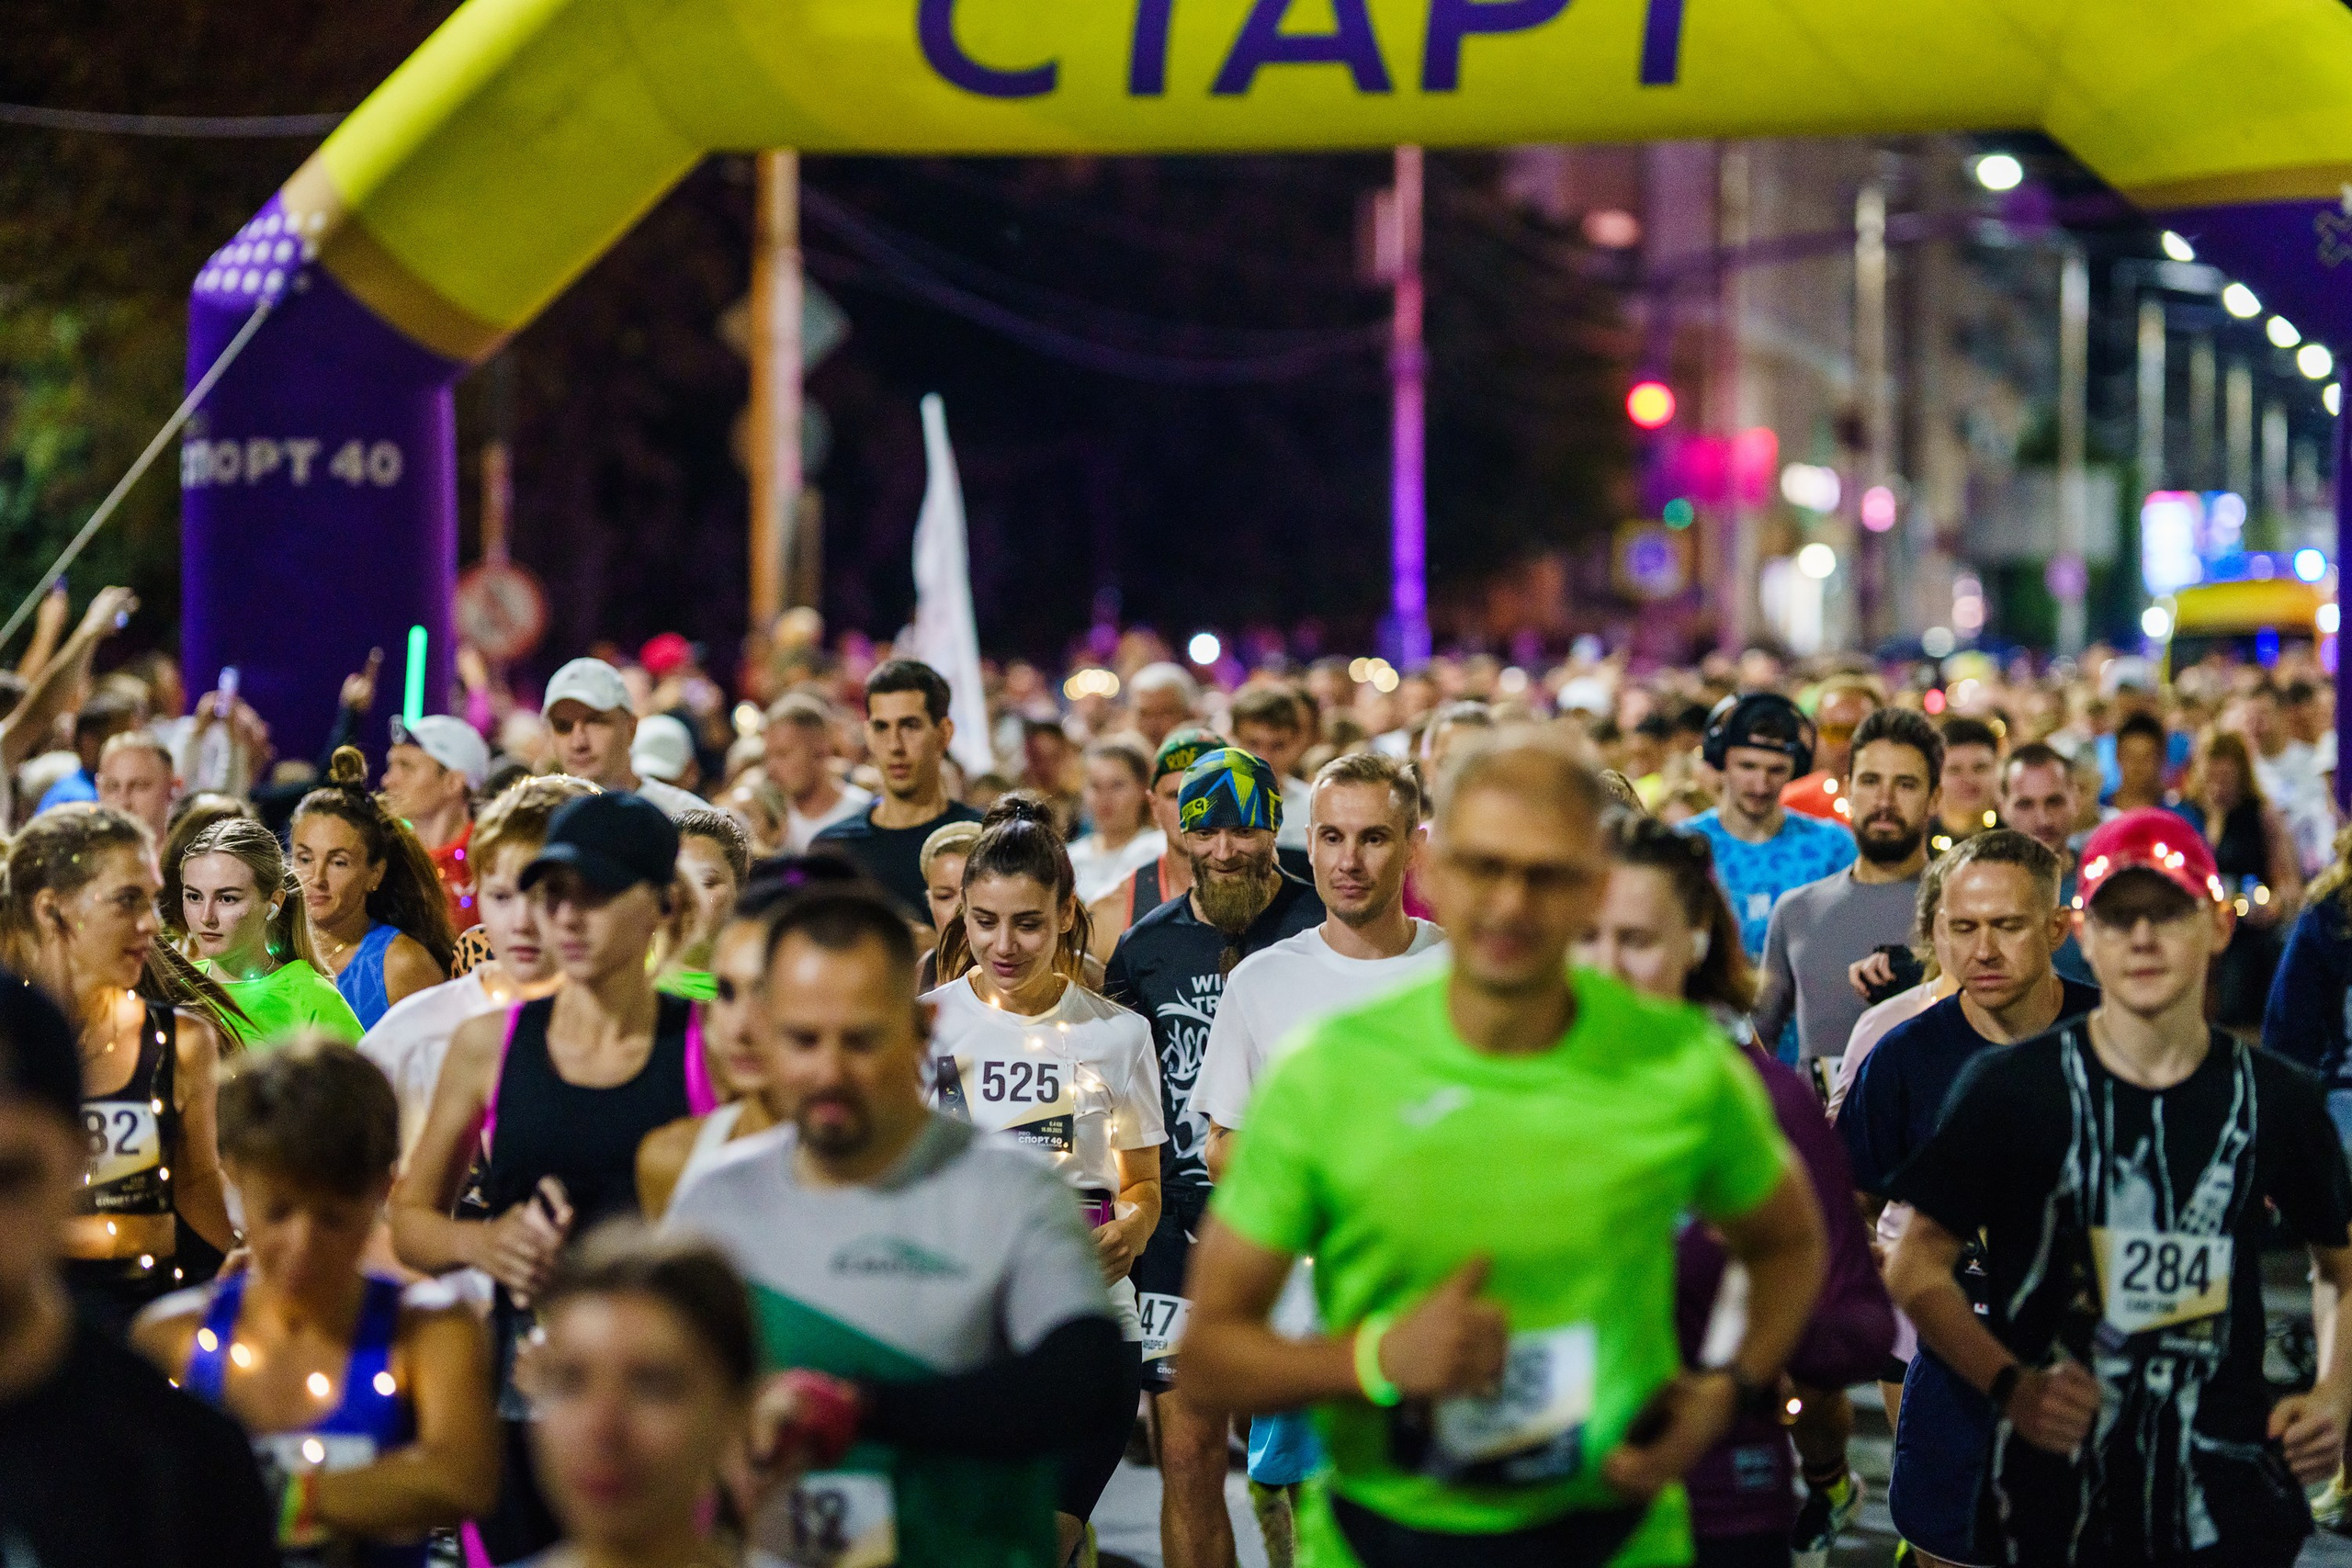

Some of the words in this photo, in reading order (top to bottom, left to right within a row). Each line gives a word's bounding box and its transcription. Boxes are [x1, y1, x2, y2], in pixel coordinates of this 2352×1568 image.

[328, 437, 403, 488] 40
[982, 1061, 1059, 1103] 525
[1018, 1135, 1050, 1144] СПОРТ
[1050, 1136, 1063, 1145] 40
[2122, 1240, 2209, 1296] 284
[1140, 1299, 1179, 1337] 47
